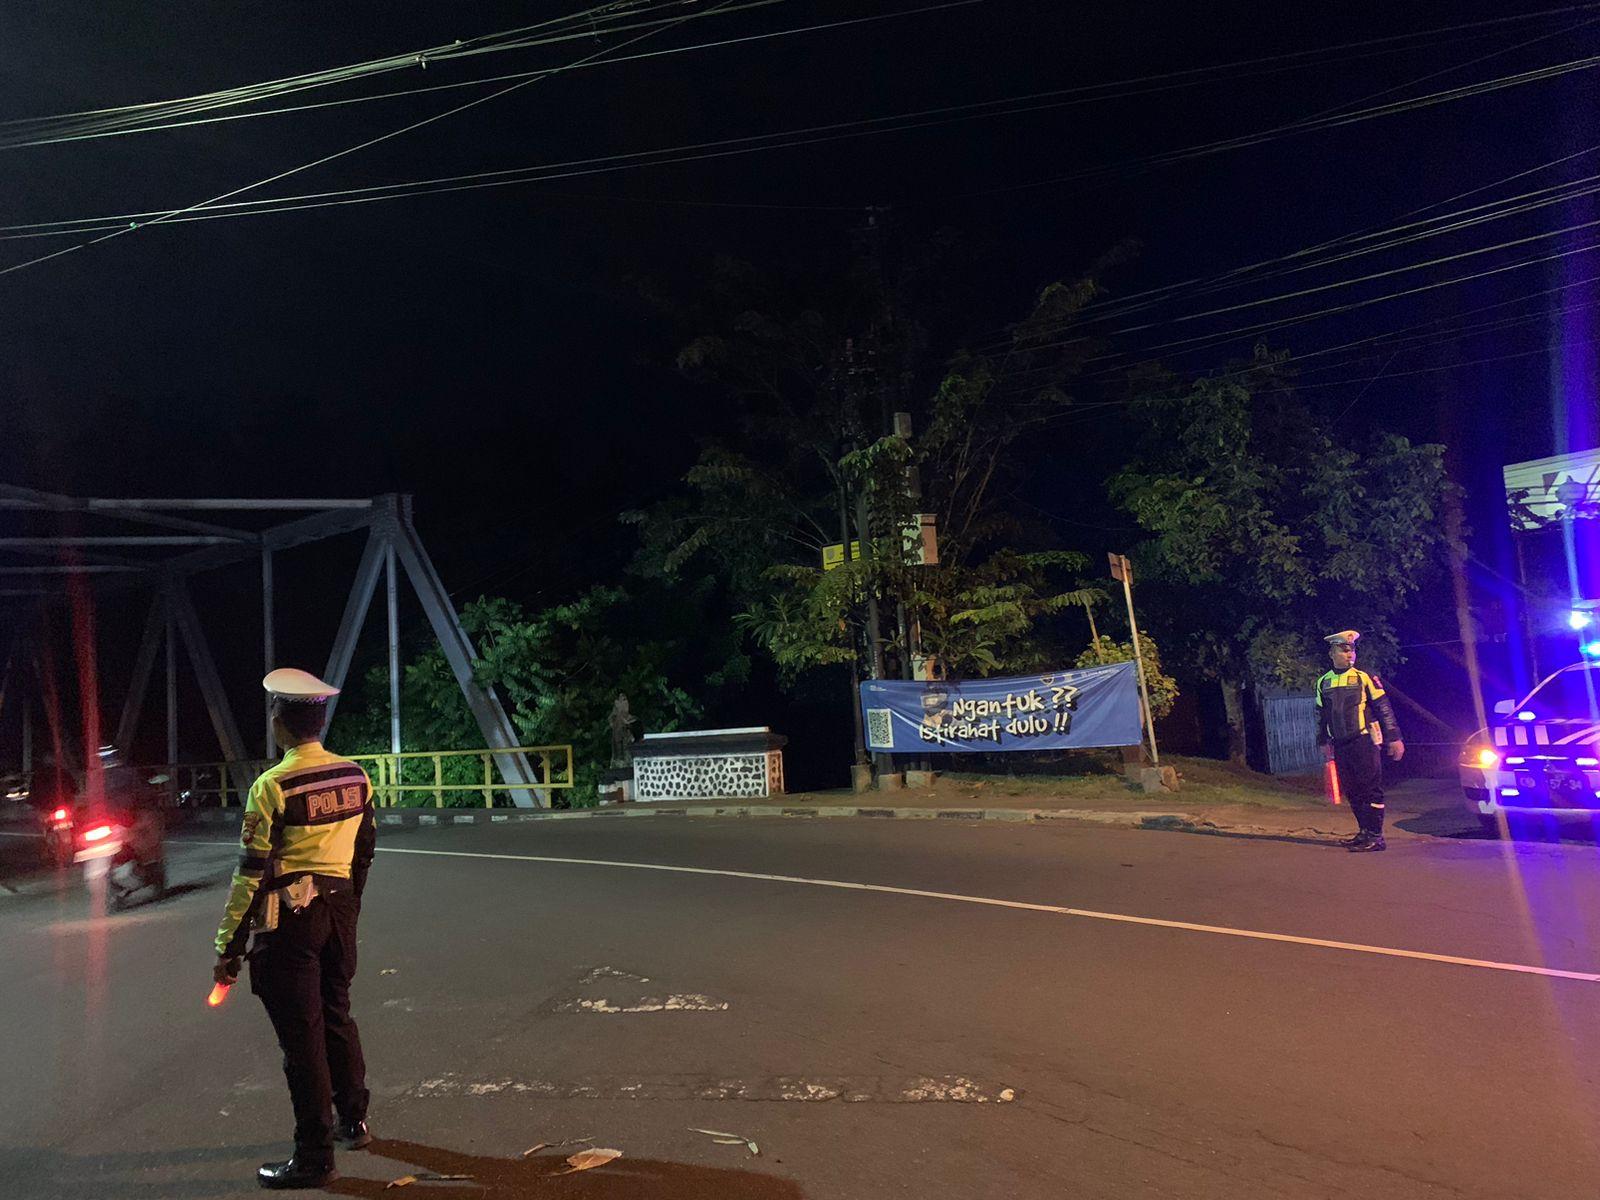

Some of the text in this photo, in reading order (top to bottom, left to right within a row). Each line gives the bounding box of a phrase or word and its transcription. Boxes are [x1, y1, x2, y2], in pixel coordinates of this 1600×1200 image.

[952, 685, 1078, 721] Ngantuk ??
[918, 712, 1068, 743] Istirahat dulu !!
[308, 786, 361, 817] POLISI
